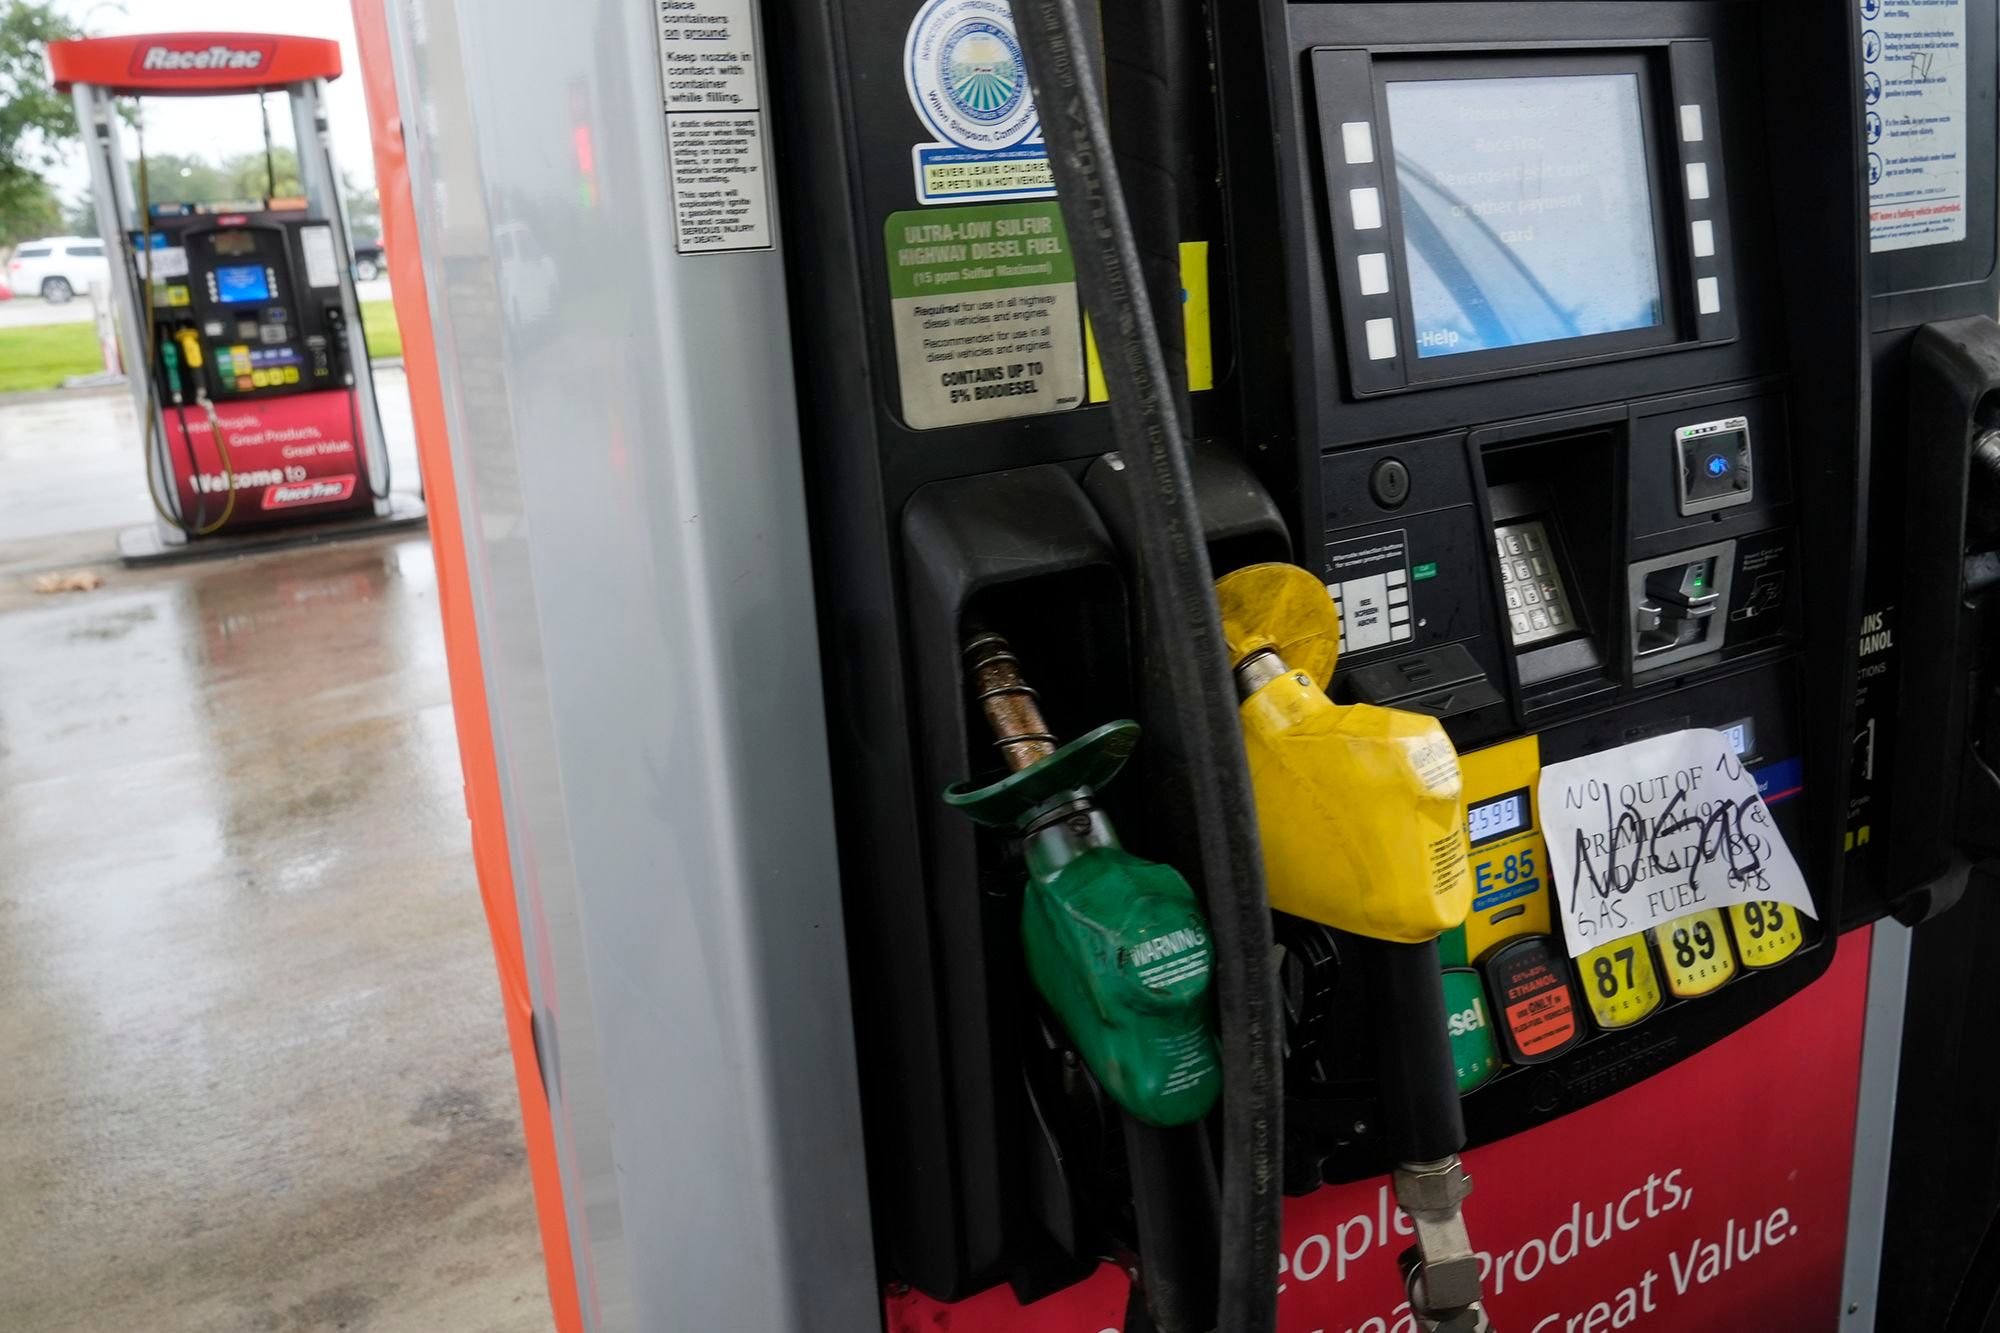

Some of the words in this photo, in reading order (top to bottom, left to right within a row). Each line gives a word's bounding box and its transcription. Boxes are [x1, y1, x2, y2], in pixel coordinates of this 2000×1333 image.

[663, 14, 729, 24] containers
[664, 29, 679, 37] on
[683, 28, 730, 39] ground.
[143, 46, 262, 70] RaceTrac
[667, 51, 696, 63] Keep
[701, 51, 737, 61] nozzle
[741, 51, 751, 61] in
[668, 66, 714, 75] contact
[719, 65, 744, 75] with
[669, 78, 727, 89] container
[670, 92, 702, 102] while
[928, 90, 949, 123] Wilton
[931, 167, 964, 178] NEVER
[969, 165, 999, 175] LEAVE
[931, 181, 946, 190] OR
[948, 179, 971, 189] PETS
[975, 178, 985, 187] IN
[986, 177, 995, 187] A
[996, 176, 1013, 186] HOT
[1472, 200, 1513, 216] other
[1518, 193, 1584, 216] payment
[724, 224, 755, 234] INJURY
[904, 221, 992, 244] ULTRA-LOW
[996, 217, 1053, 237] SULFUR
[1500, 225, 1535, 244] card
[898, 245, 967, 266] HIGHWAY
[972, 241, 1023, 260] DIESEL
[1026, 237, 1062, 255] FUEL
[913, 273, 933, 288] (15
[934, 272, 960, 285] ppm
[961, 267, 994, 281] Sulfur
[996, 261, 1052, 277] Maximum)
[914, 302, 960, 317] Required
[962, 301, 975, 311] for
[978, 301, 994, 311] use
[996, 299, 1003, 309] in
[1006, 297, 1017, 308] all
[1019, 295, 1056, 309] highway
[923, 317, 950, 329] diesel
[954, 315, 991, 326] vehicles
[993, 312, 1010, 322] and
[1012, 309, 1049, 323] engines.
[924, 333, 994, 349] Recommended
[997, 332, 1009, 342] for
[1011, 330, 1028, 340] use
[1030, 328, 1038, 338] in
[1039, 326, 1050, 337] all
[926, 350, 955, 363] diesel
[957, 347, 994, 361] vehicles
[996, 343, 1012, 355] and
[1014, 340, 1053, 354] engines.
[942, 367, 1004, 387] CONTAINS
[1007, 364, 1025, 379] UP
[1028, 361, 1044, 376] TO
[951, 388, 970, 404] 5%
[974, 380, 1038, 400] BIODIESEL
[188, 467, 284, 496] Welcome
[284, 464, 307, 483] to
[273, 482, 344, 504] RaceTrac
[1354, 607, 1379, 619] SCREEN
[1360, 598, 1372, 607] SEE
[1357, 617, 1378, 627] ABOVE
[1620, 774, 1669, 807] OUT
[1675, 766, 1703, 800] OF
[1720, 833, 1772, 864] (89)
[1475, 848, 1535, 894] E-85
[1648, 880, 1707, 918] FUEL
[1743, 901, 1784, 939] 93
[1130, 927, 1207, 968] WARNING
[1672, 920, 1715, 969] 89
[1746, 932, 1797, 958] PRESS
[1593, 946, 1635, 999] 87
[1676, 960, 1730, 988] PRESS
[1508, 974, 1558, 1000] ETHANOL
[1528, 995, 1552, 1013] ONLY
[1609, 990, 1655, 1014] RESS
[1447, 997, 1486, 1039] sel
[1668, 1206, 1798, 1297] Value.
